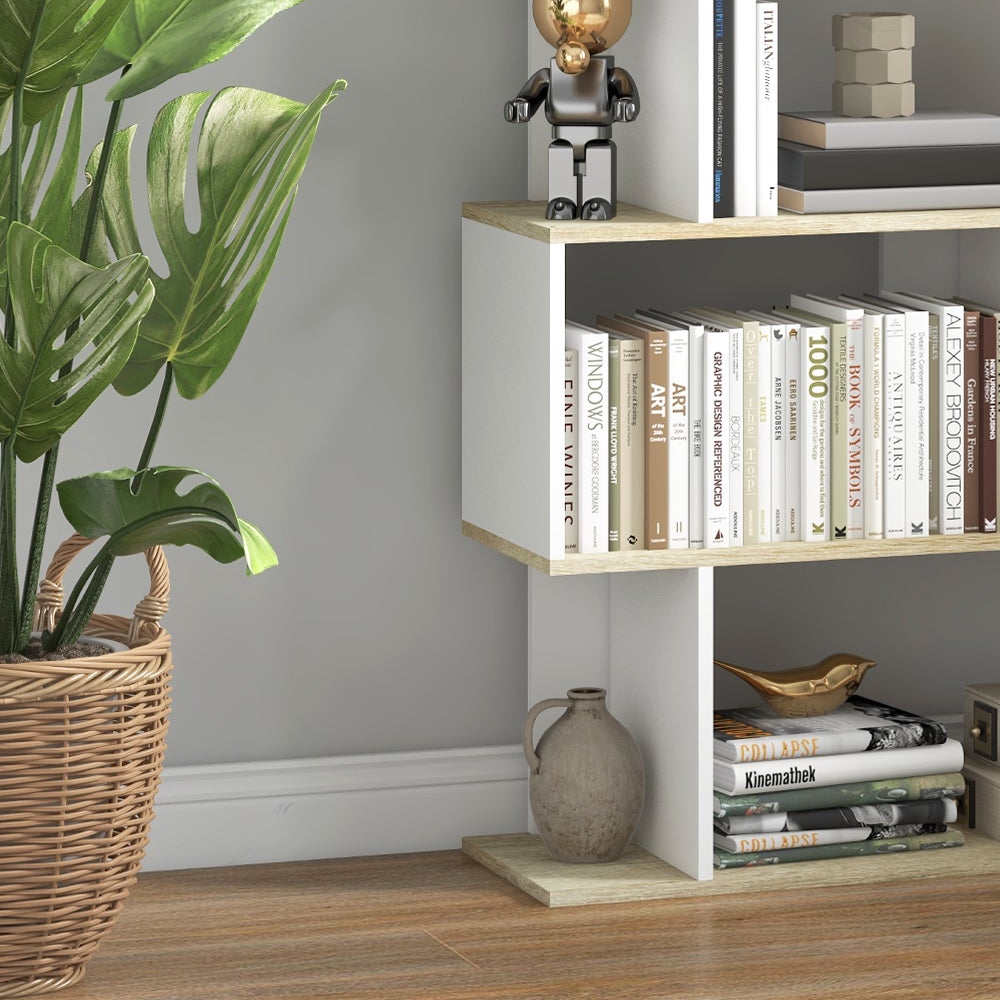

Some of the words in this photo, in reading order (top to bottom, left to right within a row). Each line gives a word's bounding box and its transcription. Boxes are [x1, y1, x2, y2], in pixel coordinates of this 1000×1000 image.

[808, 335, 829, 398] 1000
[946, 313, 961, 388] ALEXEY
[587, 341, 604, 431] WINDOWS
[713, 351, 722, 397] GRAPHIC
[849, 365, 861, 410] BOOK
[610, 406, 618, 430] FRANK
[651, 383, 667, 418] ART
[672, 383, 687, 417] ART
[713, 400, 722, 437] DESIGN
[967, 378, 976, 422] Gardens
[610, 432, 618, 454] LLOYD
[730, 415, 741, 472] BORDEAUX
[892, 372, 903, 480] ANTIQUAIRES
[967, 424, 976, 435] in
[610, 456, 618, 485] WRIGHT
[713, 440, 722, 507] REFERENCED
[744, 447, 758, 495] Top
[849, 427, 861, 508] SYMBOLS
[946, 394, 961, 520] BRODOVITCH
[967, 437, 976, 474] France
[740, 738, 818, 762] COLLAPSE
[745, 765, 816, 789] Kinemathek
[740, 833, 818, 853] COLLAPSE
